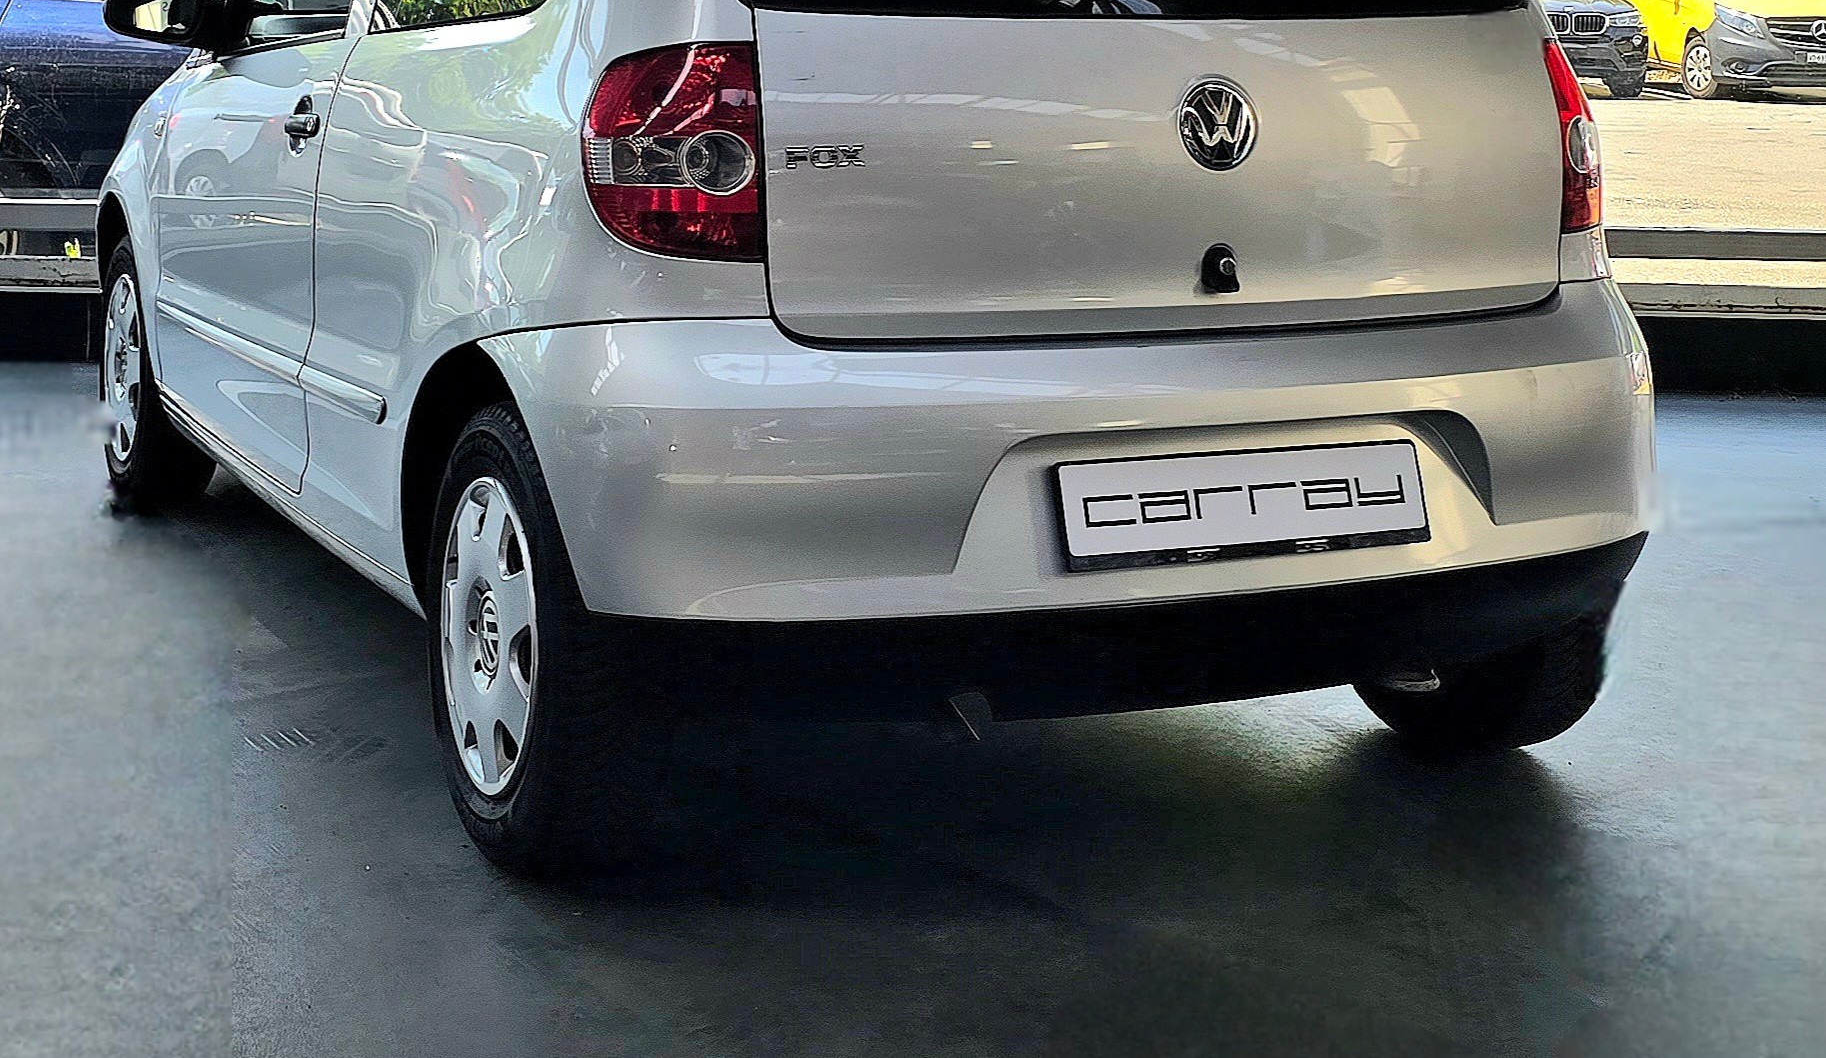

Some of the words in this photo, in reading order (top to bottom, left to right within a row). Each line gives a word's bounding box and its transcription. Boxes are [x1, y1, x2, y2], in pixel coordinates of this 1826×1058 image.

[1180, 82, 1256, 169] VW
[785, 145, 866, 170] FOX
[1082, 474, 1406, 529] carray
